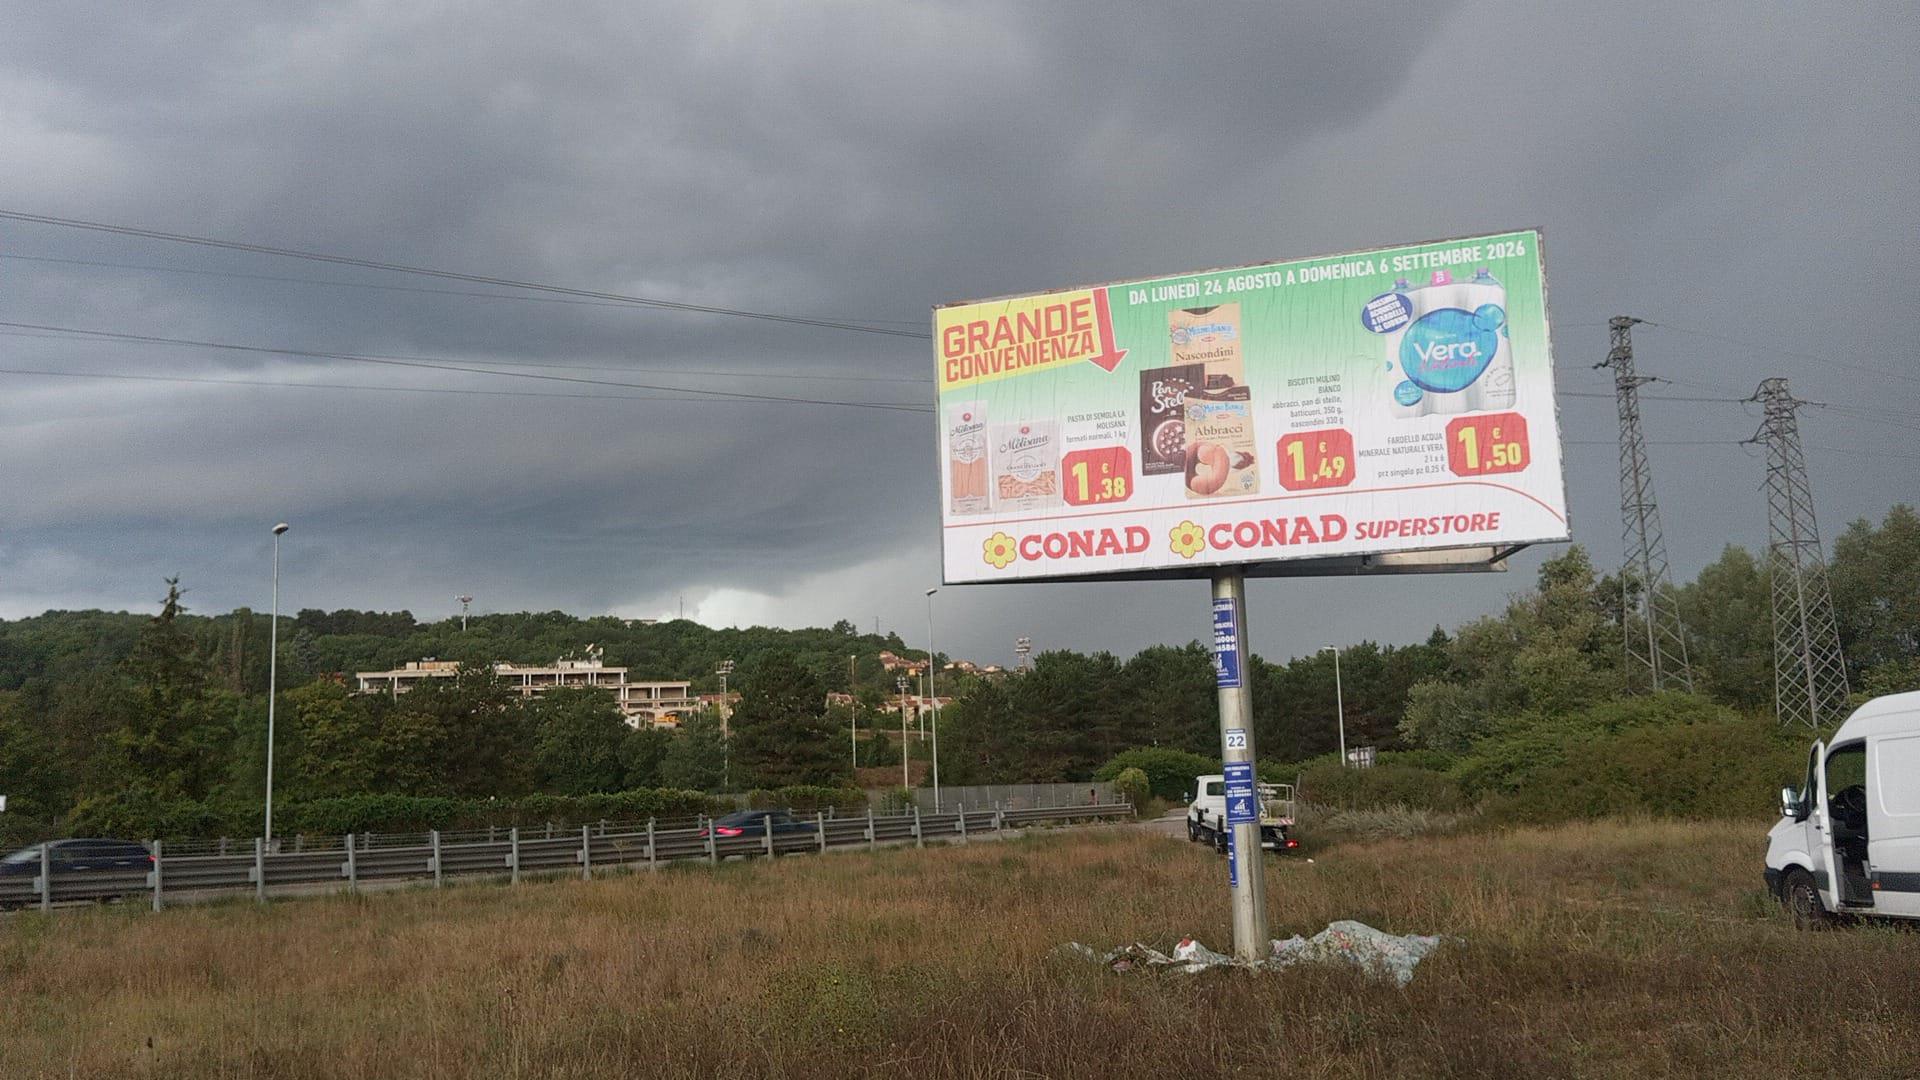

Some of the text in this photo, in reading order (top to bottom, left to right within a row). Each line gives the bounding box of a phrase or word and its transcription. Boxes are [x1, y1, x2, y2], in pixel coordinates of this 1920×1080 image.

[1129, 240, 1526, 305] DA LUNEDÌ 24 AGOSTO A DOMENICA 6 SETTEMBRE 2026
[943, 298, 1093, 358] GRANDE
[946, 331, 1095, 382] CONVENIENZA
[1176, 346, 1234, 361] Nascondini
[1413, 341, 1482, 363] Vera
[1152, 381, 1171, 397] Pan
[1318, 384, 1341, 394] BIANCO
[1151, 389, 1189, 413] Stell
[1067, 410, 1126, 423] PASTA DI SEMOLA LA
[1097, 420, 1126, 430] MOLISANA
[1195, 423, 1243, 437] Abbracci
[1388, 431, 1443, 444] FARDELLO ACQUA
[1359, 443, 1444, 457] MINERALE NATURALE VERA
[1390, 467, 1415, 477] singolo
[1209, 512, 1500, 550] CONAD SUPERSTORE
[1019, 526, 1150, 561] CONAD
[1228, 735, 1245, 747] 22
